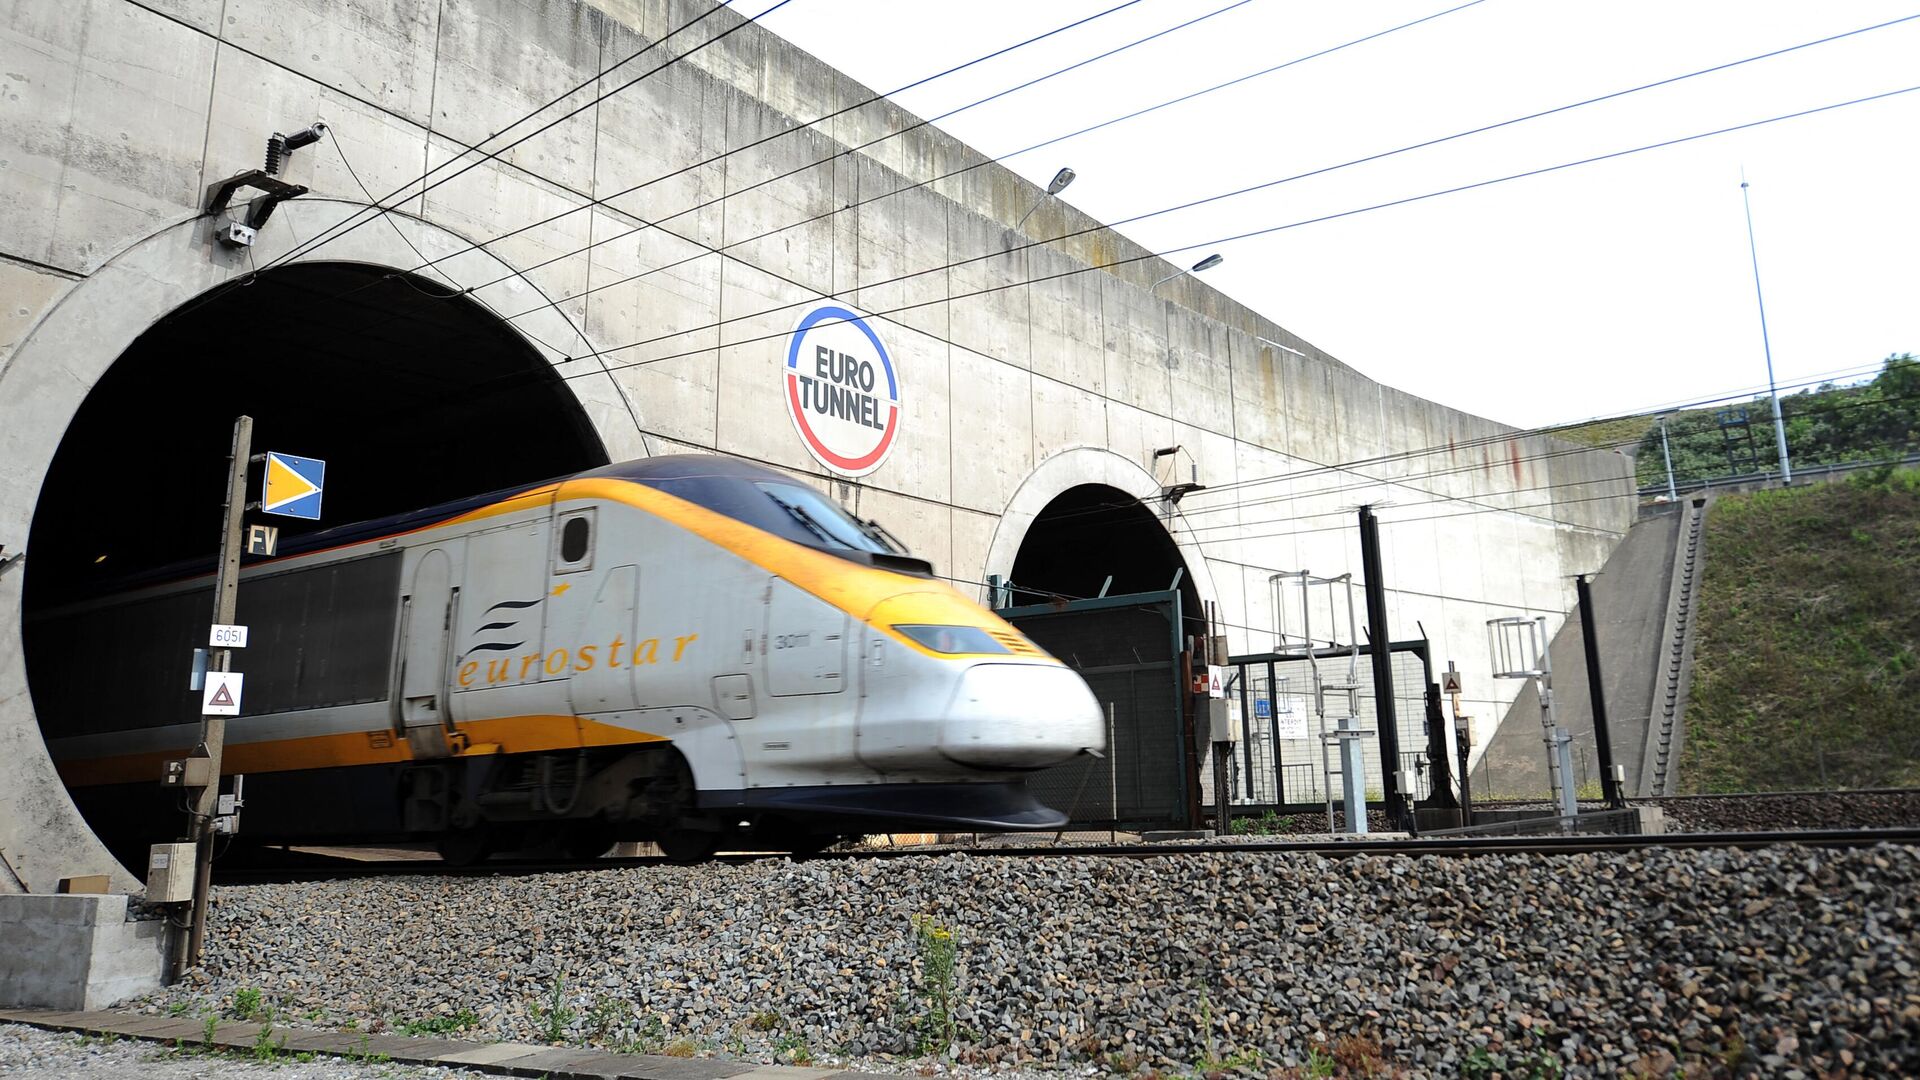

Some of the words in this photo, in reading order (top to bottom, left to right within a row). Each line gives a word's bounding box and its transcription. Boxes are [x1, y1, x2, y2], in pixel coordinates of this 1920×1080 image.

[816, 345, 874, 392] EURO
[800, 375, 884, 430] TUNNEL
[248, 524, 278, 556] FV
[216, 629, 242, 643] 6051
[458, 633, 698, 687] eurostar
